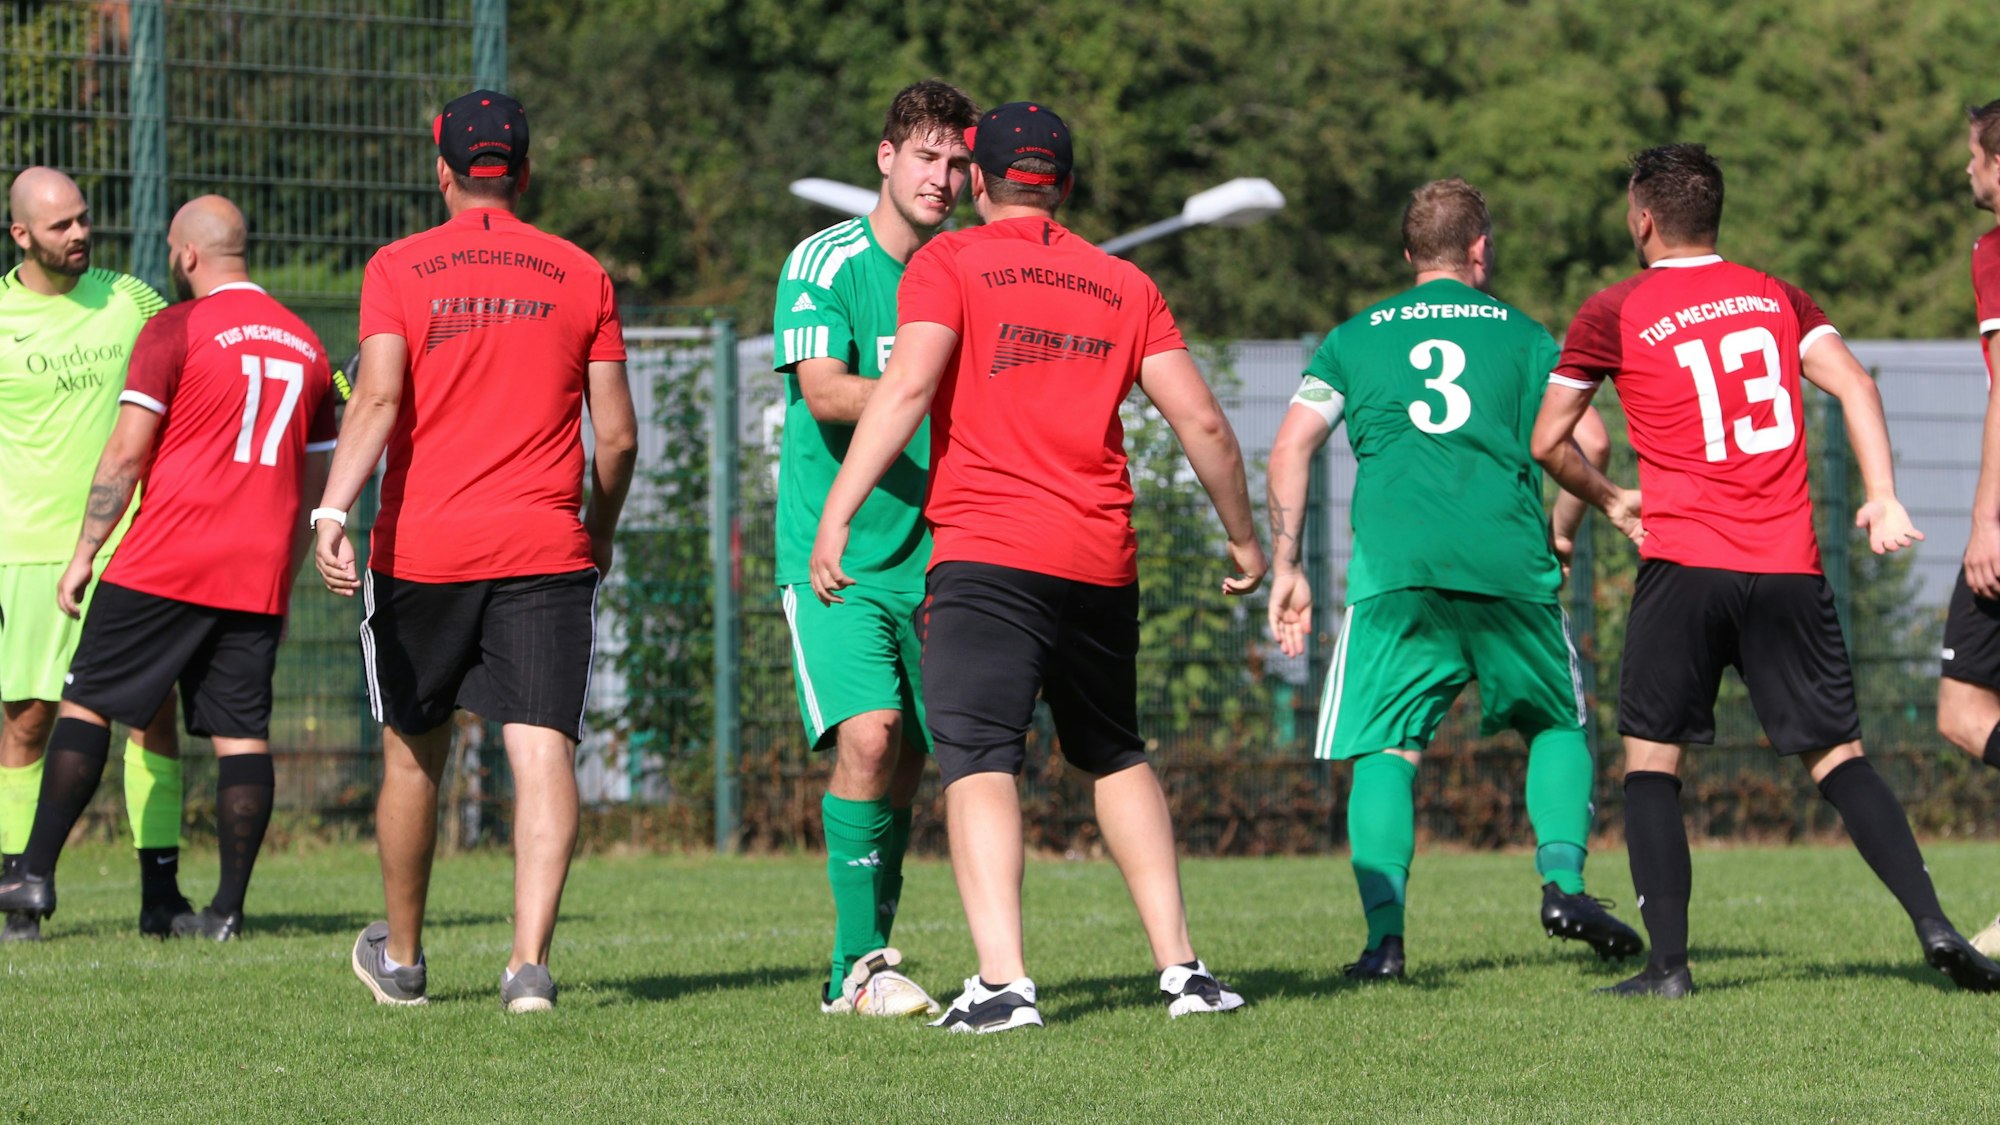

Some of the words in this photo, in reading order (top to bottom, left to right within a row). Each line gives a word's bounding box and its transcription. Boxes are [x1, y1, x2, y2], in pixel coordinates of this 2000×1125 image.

[411, 256, 447, 279] TUS
[451, 249, 566, 284] MECHERNICH
[981, 268, 1017, 289] TUS
[1021, 267, 1123, 311] MECHERNICH
[429, 297, 557, 319] Transhoff
[1370, 307, 1396, 326] SV
[1400, 302, 1508, 321] SÖTENICH
[214, 327, 244, 349] TUS
[241, 324, 317, 363] MECHERNICH
[999, 323, 1117, 358] Transhoff
[1638, 316, 1677, 346] TUS
[1408, 338, 1472, 434] 3
[1673, 326, 1796, 463] 13
[233, 354, 304, 467] 17
